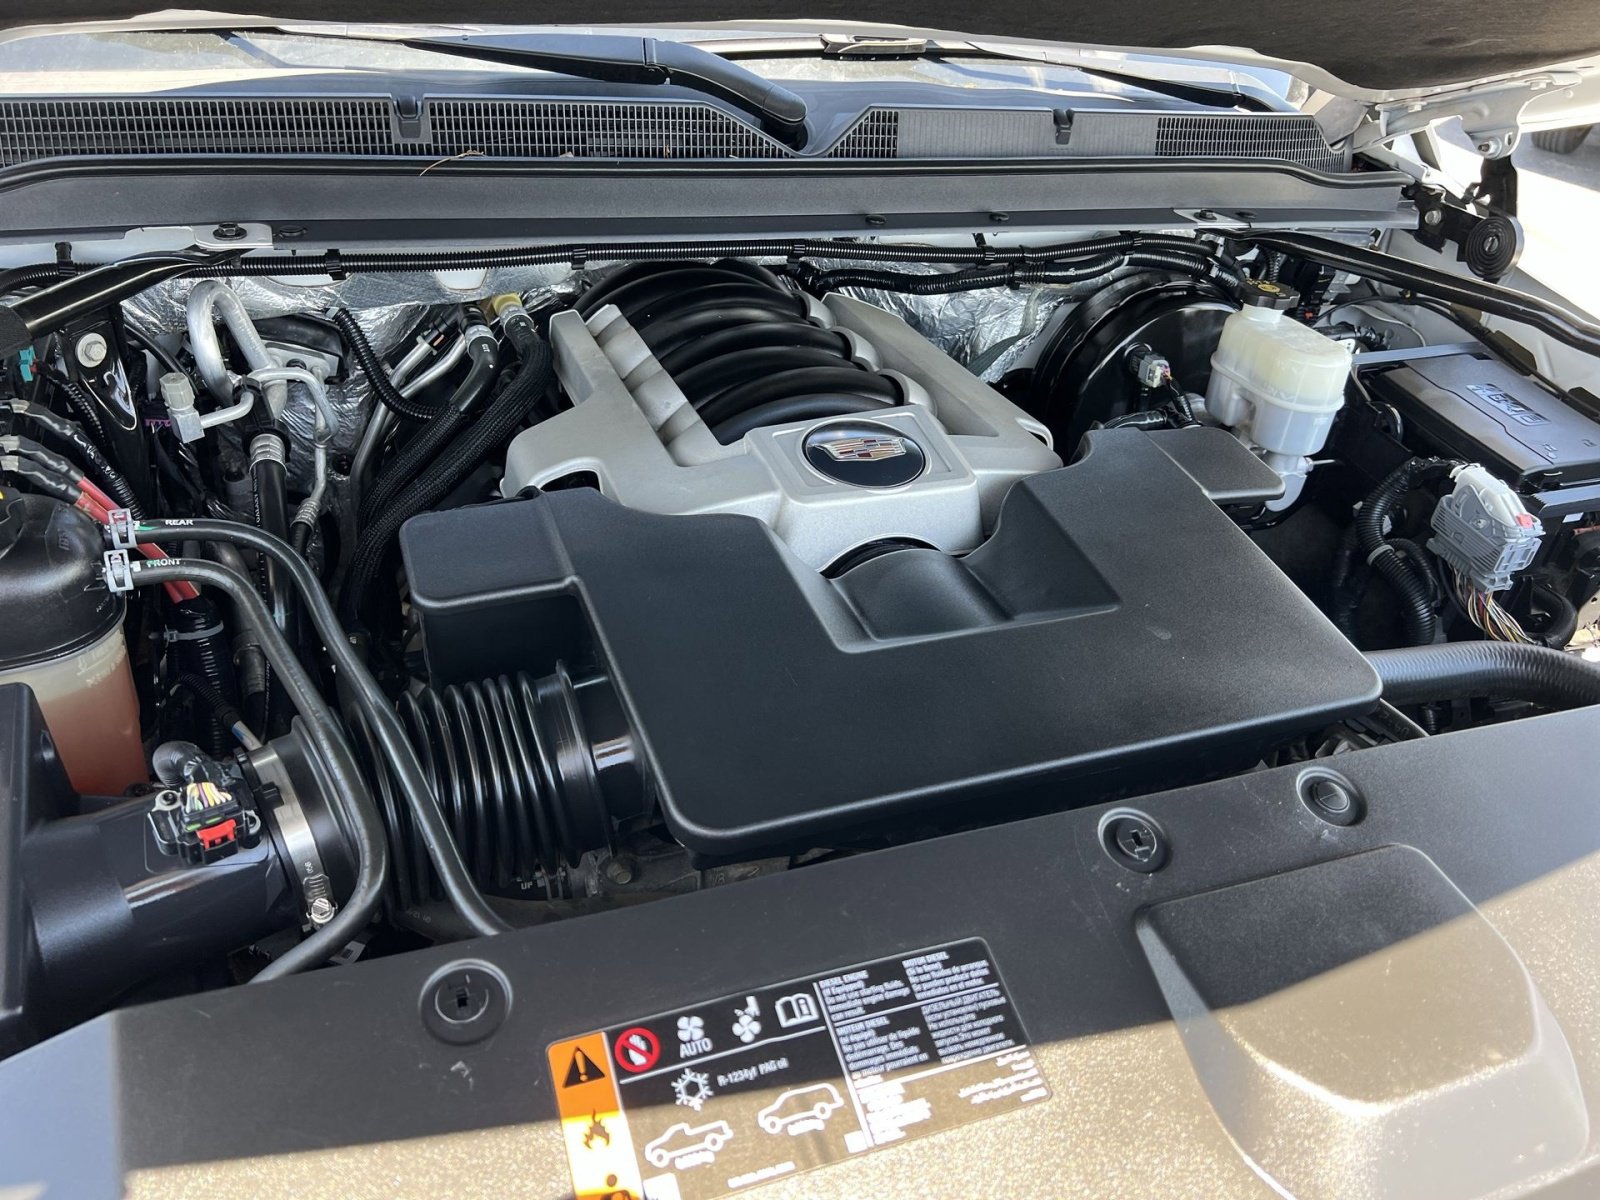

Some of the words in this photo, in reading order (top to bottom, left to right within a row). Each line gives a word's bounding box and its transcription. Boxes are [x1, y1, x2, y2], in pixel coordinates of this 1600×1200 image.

[146, 558, 182, 568] FRONT
[902, 957, 926, 967] MOTOR
[925, 951, 948, 962] DIESEL
[819, 977, 843, 987] DIESEL
[842, 971, 868, 982] ENGINE
[836, 1022, 865, 1034] MOTEUR
[864, 1016, 889, 1028] DIESEL
[680, 1038, 713, 1058] AUTO
[716, 1066, 758, 1087] R-1234yf
[758, 1060, 777, 1075] PAG
[777, 1057, 790, 1070] oil
